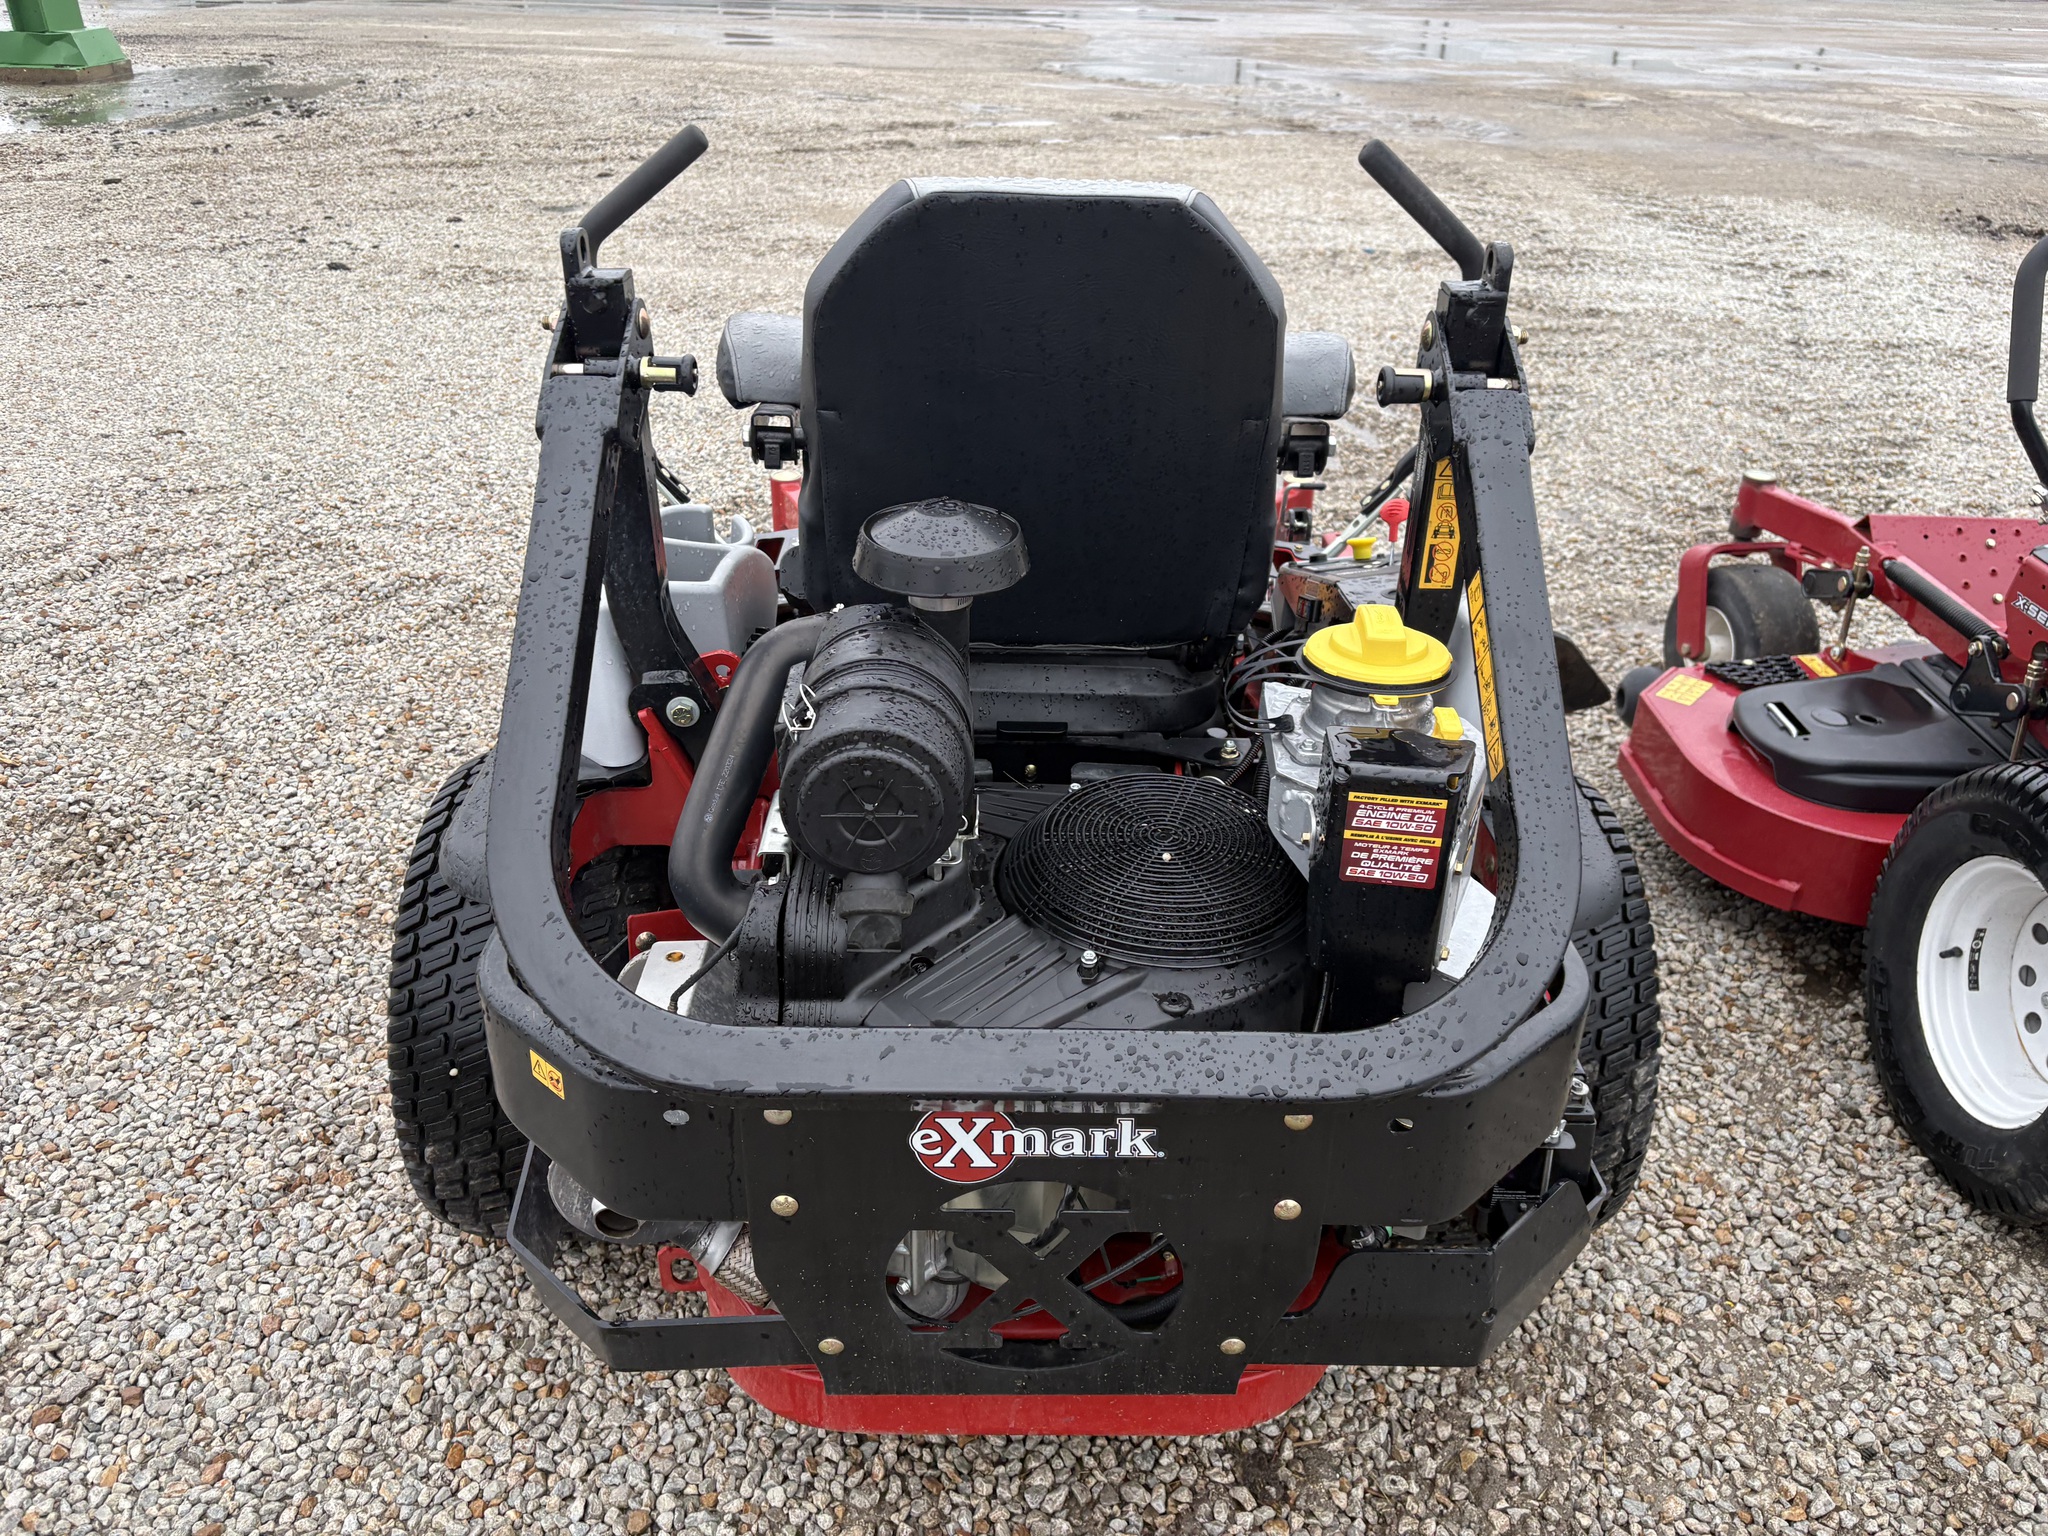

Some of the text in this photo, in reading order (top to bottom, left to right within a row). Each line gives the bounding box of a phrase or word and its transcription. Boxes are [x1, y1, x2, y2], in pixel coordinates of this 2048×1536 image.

[1356, 809, 1438, 823] ENGINE OIL
[1396, 807, 1435, 815] PREMIUM
[1355, 818, 1434, 832] SAE 10W-50
[1354, 842, 1390, 850] MOTEUR
[1373, 848, 1409, 856] EXMARK
[1351, 851, 1434, 865] DE PREMIÈRE
[1361, 860, 1422, 872] QUALITÉ
[1349, 868, 1426, 881] SAE 10W-50
[909, 1116, 1161, 1169] eXmark
